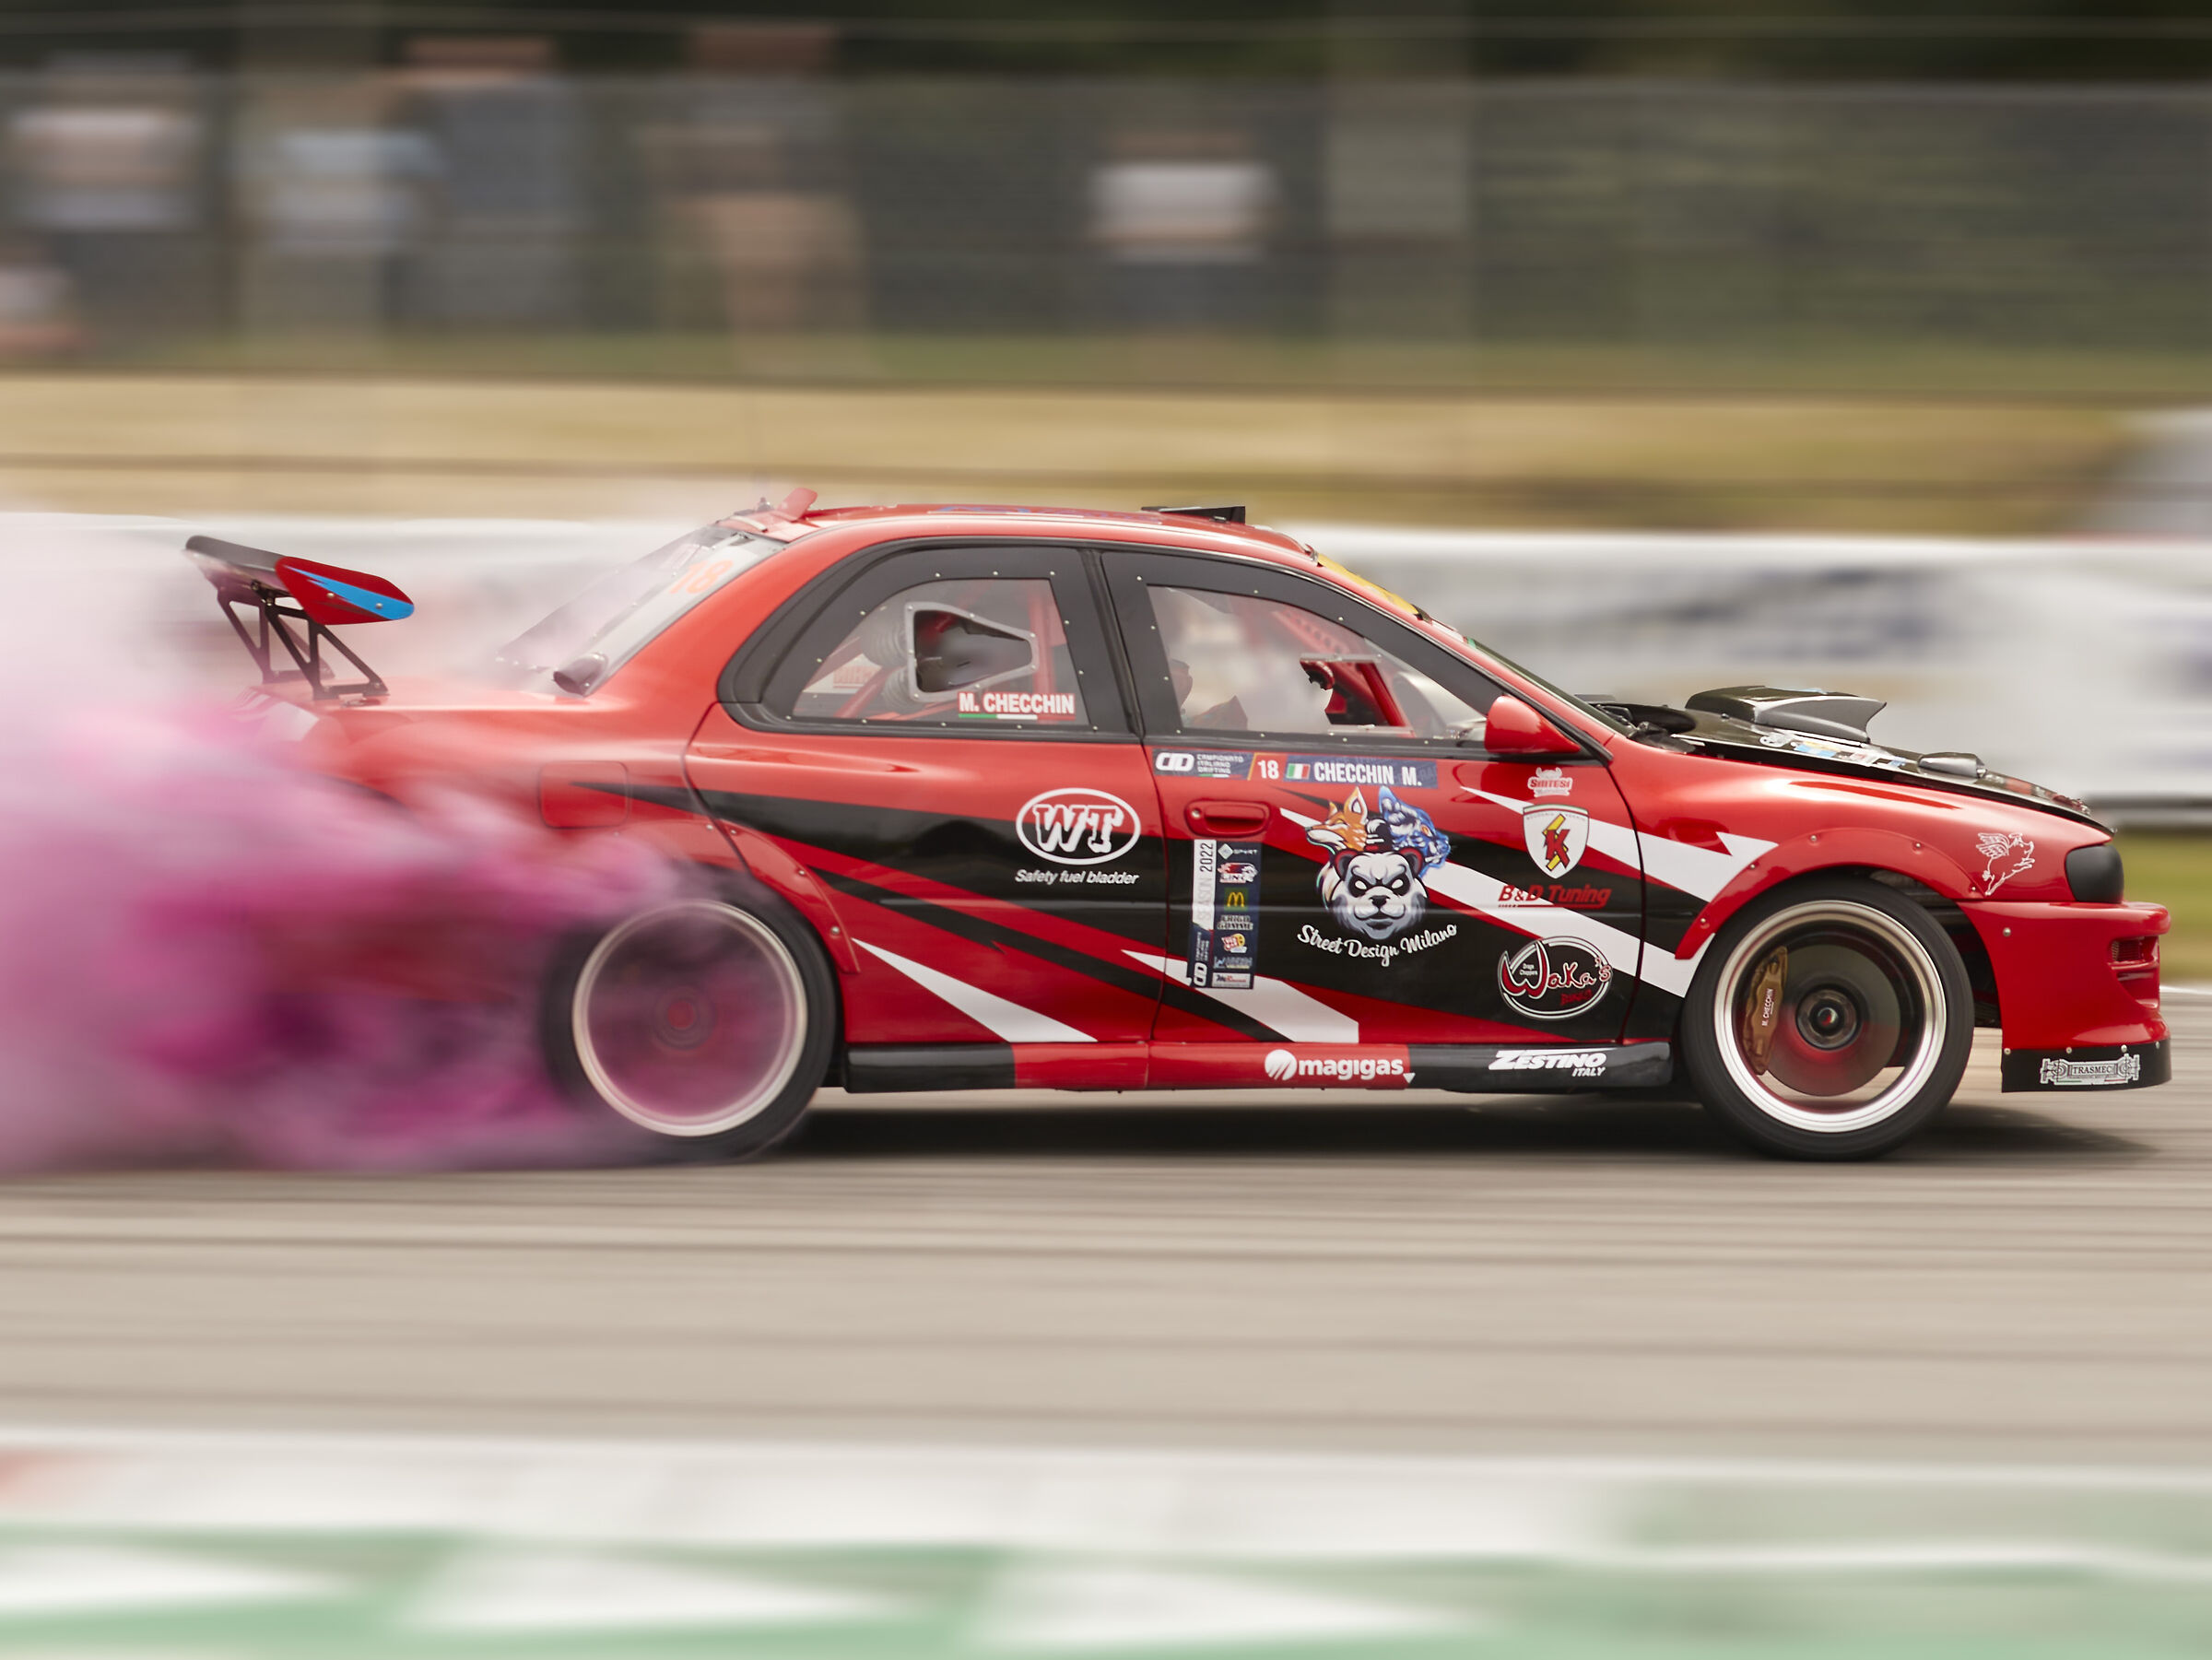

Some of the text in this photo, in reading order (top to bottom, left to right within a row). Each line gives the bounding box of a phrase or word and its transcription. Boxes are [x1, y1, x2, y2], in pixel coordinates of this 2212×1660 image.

[668, 559, 734, 595] 18
[959, 692, 1075, 714] M. CHECCHIN
[1257, 759, 1279, 780] 18
[1313, 761, 1394, 785] CHECCHIN
[1401, 766, 1423, 786] M.
[1032, 804, 1124, 854] WT
[1199, 842, 1214, 873] 2022
[1015, 869, 1139, 885] Safety fuel bladder
[1498, 884, 1612, 910] B&D Tuning
[1297, 924, 1457, 967] Street Design Milano
[1299, 1057, 1404, 1080] magigas
[1488, 1049, 1607, 1070] ZESTINO
[2073, 1065, 2112, 1074] TRASMEC
[1571, 1067, 1606, 1077] ITALY
